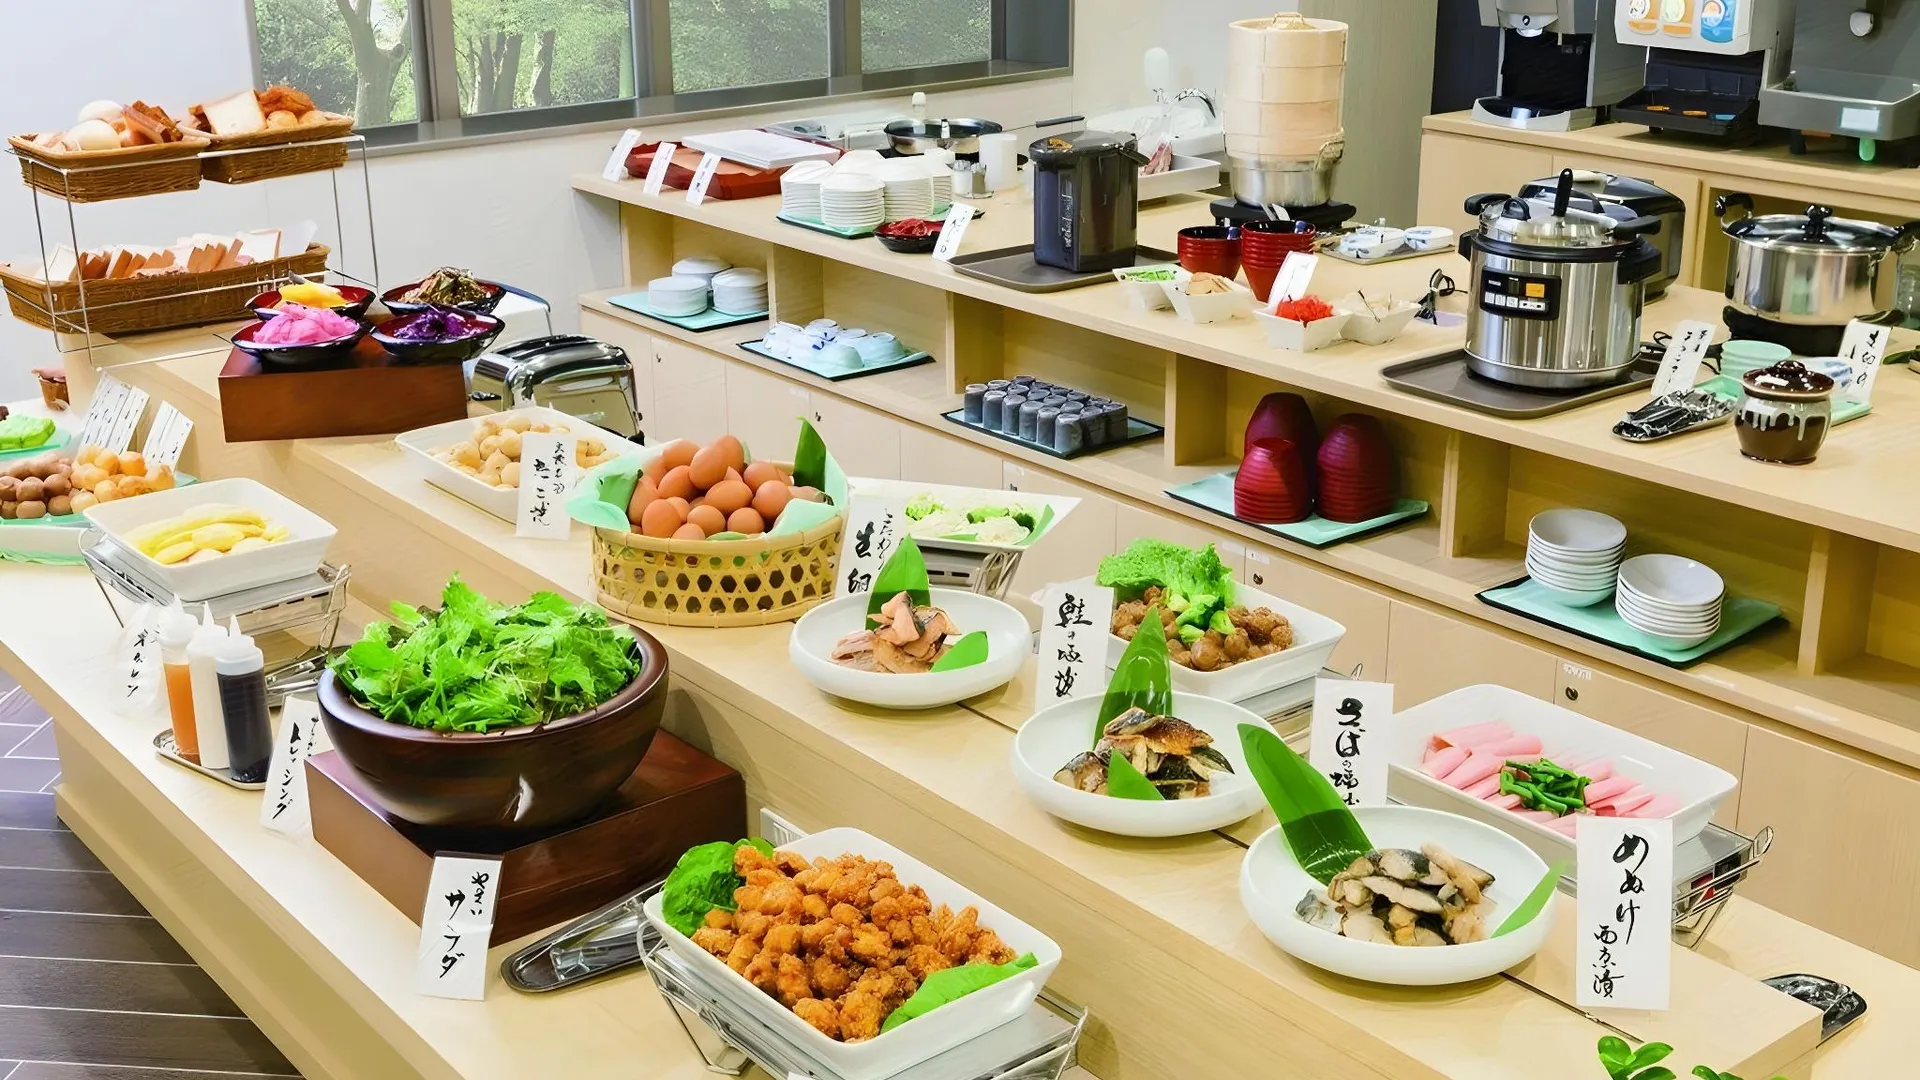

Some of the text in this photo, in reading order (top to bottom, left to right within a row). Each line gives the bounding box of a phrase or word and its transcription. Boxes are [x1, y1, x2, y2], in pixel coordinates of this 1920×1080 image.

[847, 521, 876, 594] 生卵
[470, 871, 490, 916] やさい
[1612, 832, 1650, 945] めぬけ
[439, 888, 466, 979] サラダ
[1592, 923, 1625, 999] 西京漬
